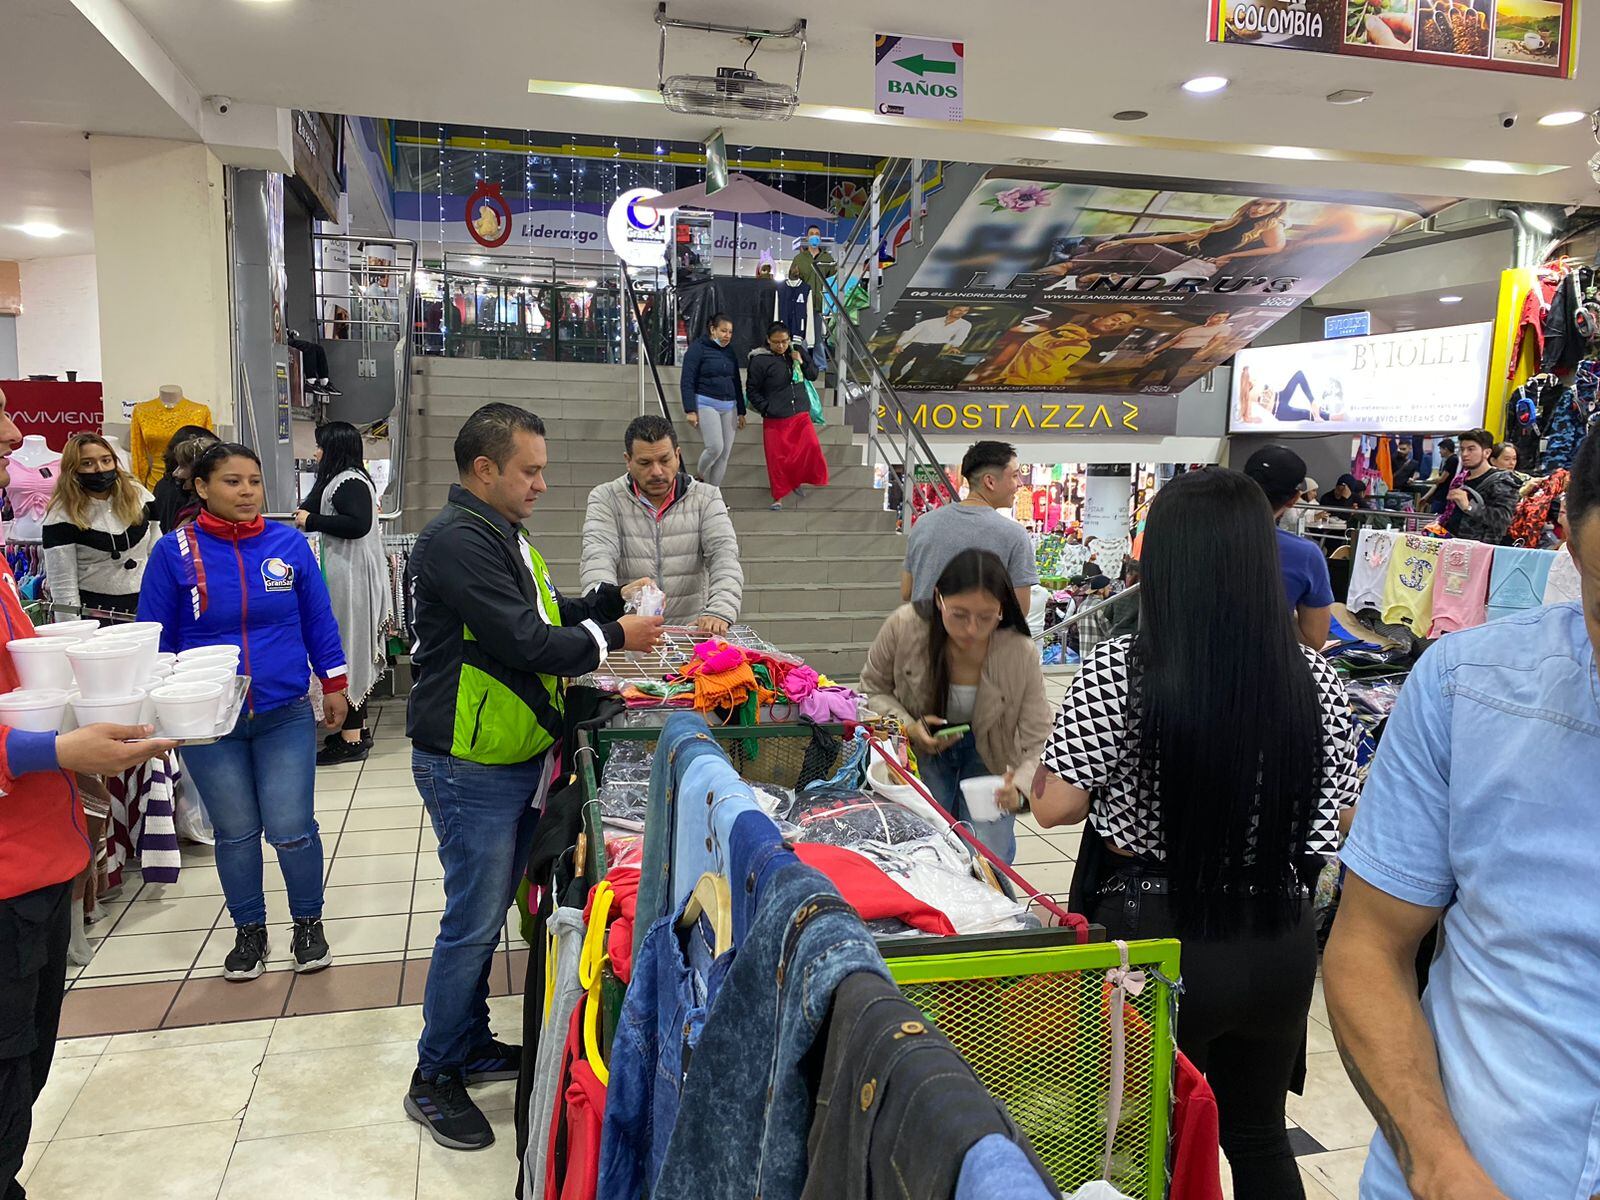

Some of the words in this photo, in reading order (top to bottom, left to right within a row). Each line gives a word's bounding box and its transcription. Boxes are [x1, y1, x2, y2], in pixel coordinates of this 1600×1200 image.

[1233, 4, 1323, 38] COLOMBIA
[888, 79, 958, 98] BAÑOS
[521, 224, 599, 243] Liderazgo
[713, 234, 758, 250] dición
[796, 293, 805, 303] A
[1351, 332, 1479, 373] BVIOLET
[897, 403, 1113, 429] MOSTAZZA
